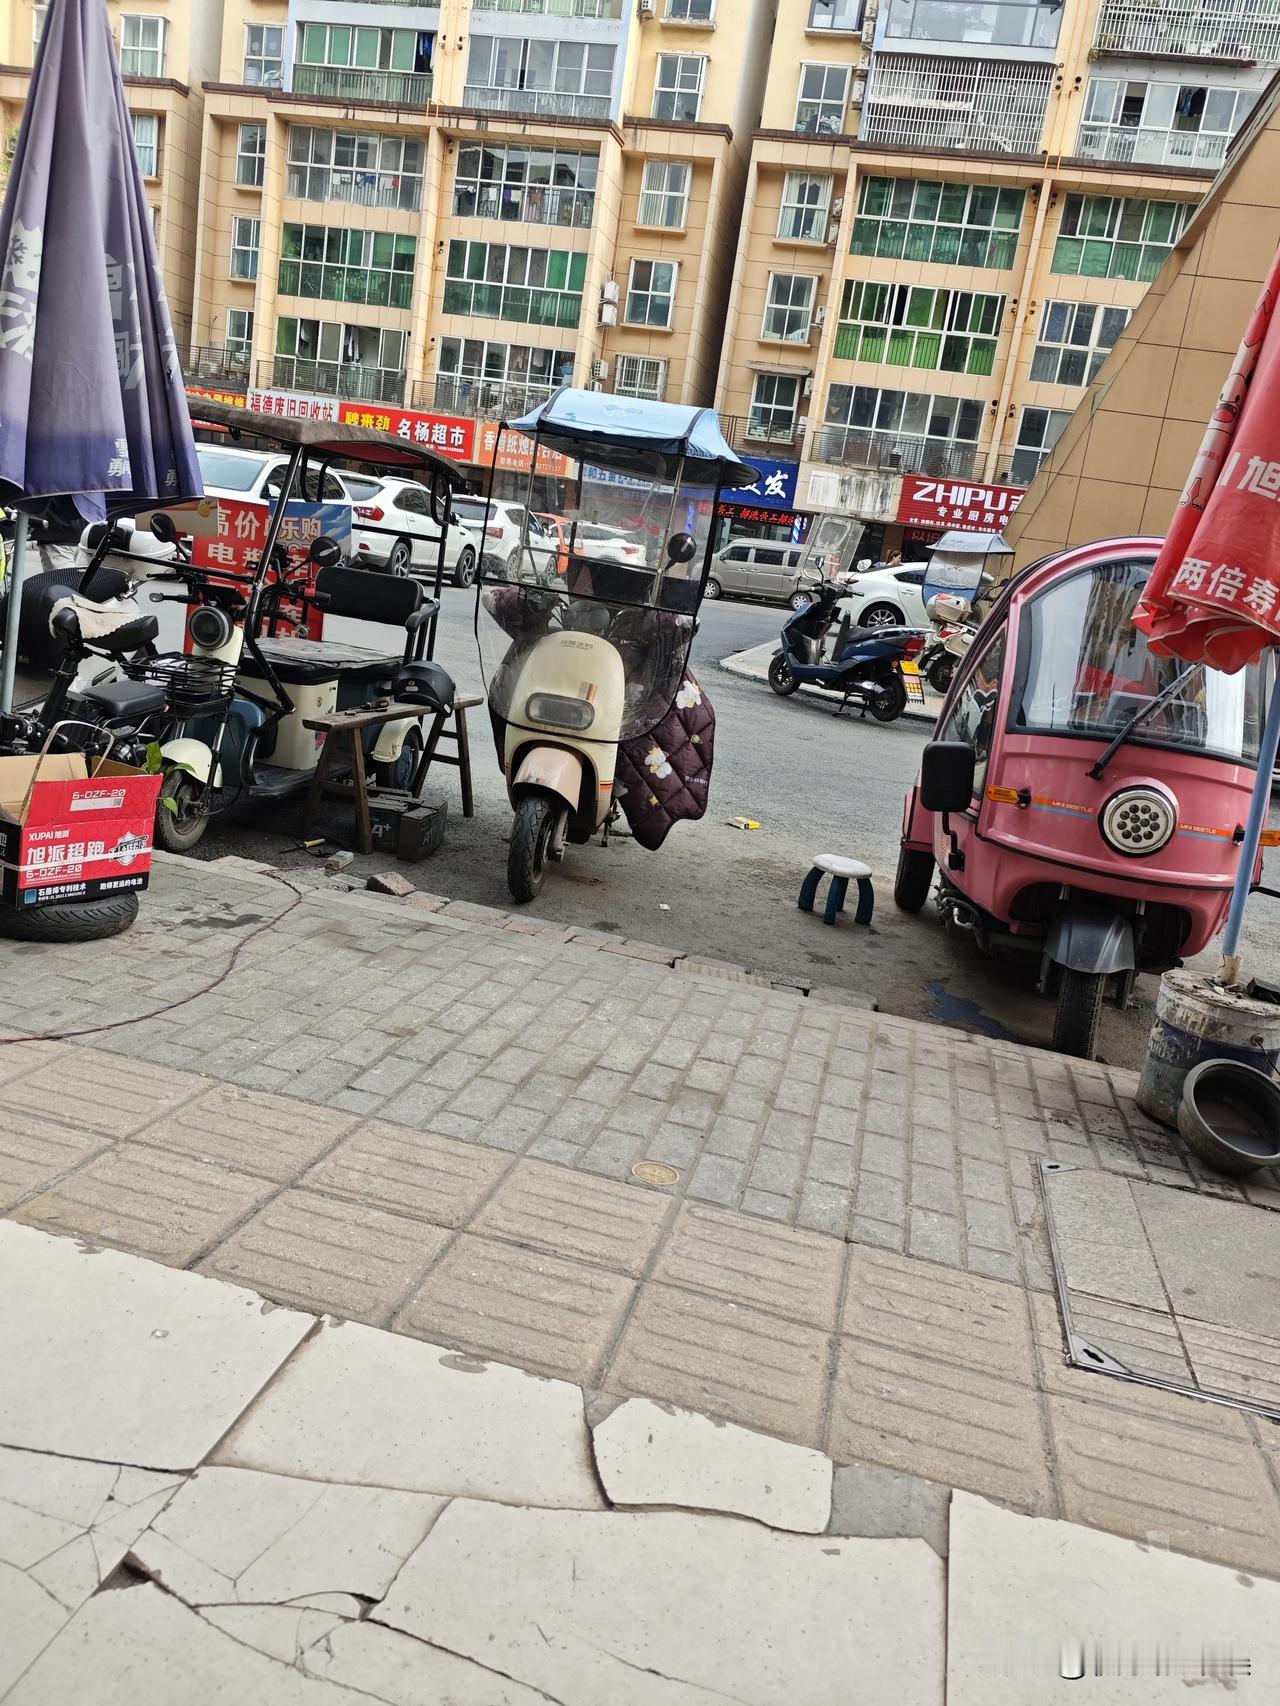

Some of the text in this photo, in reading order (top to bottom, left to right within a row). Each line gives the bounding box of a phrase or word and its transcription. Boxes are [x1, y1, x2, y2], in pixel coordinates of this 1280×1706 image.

[250, 391, 334, 422] 福德废旧回收站
[397, 417, 466, 447] 名杨超市
[913, 480, 1008, 511] ZHIPU
[1172, 556, 1280, 622] 两倍寿
[29, 831, 54, 841] XUPAI
[27, 841, 105, 865] 旭派超跑
